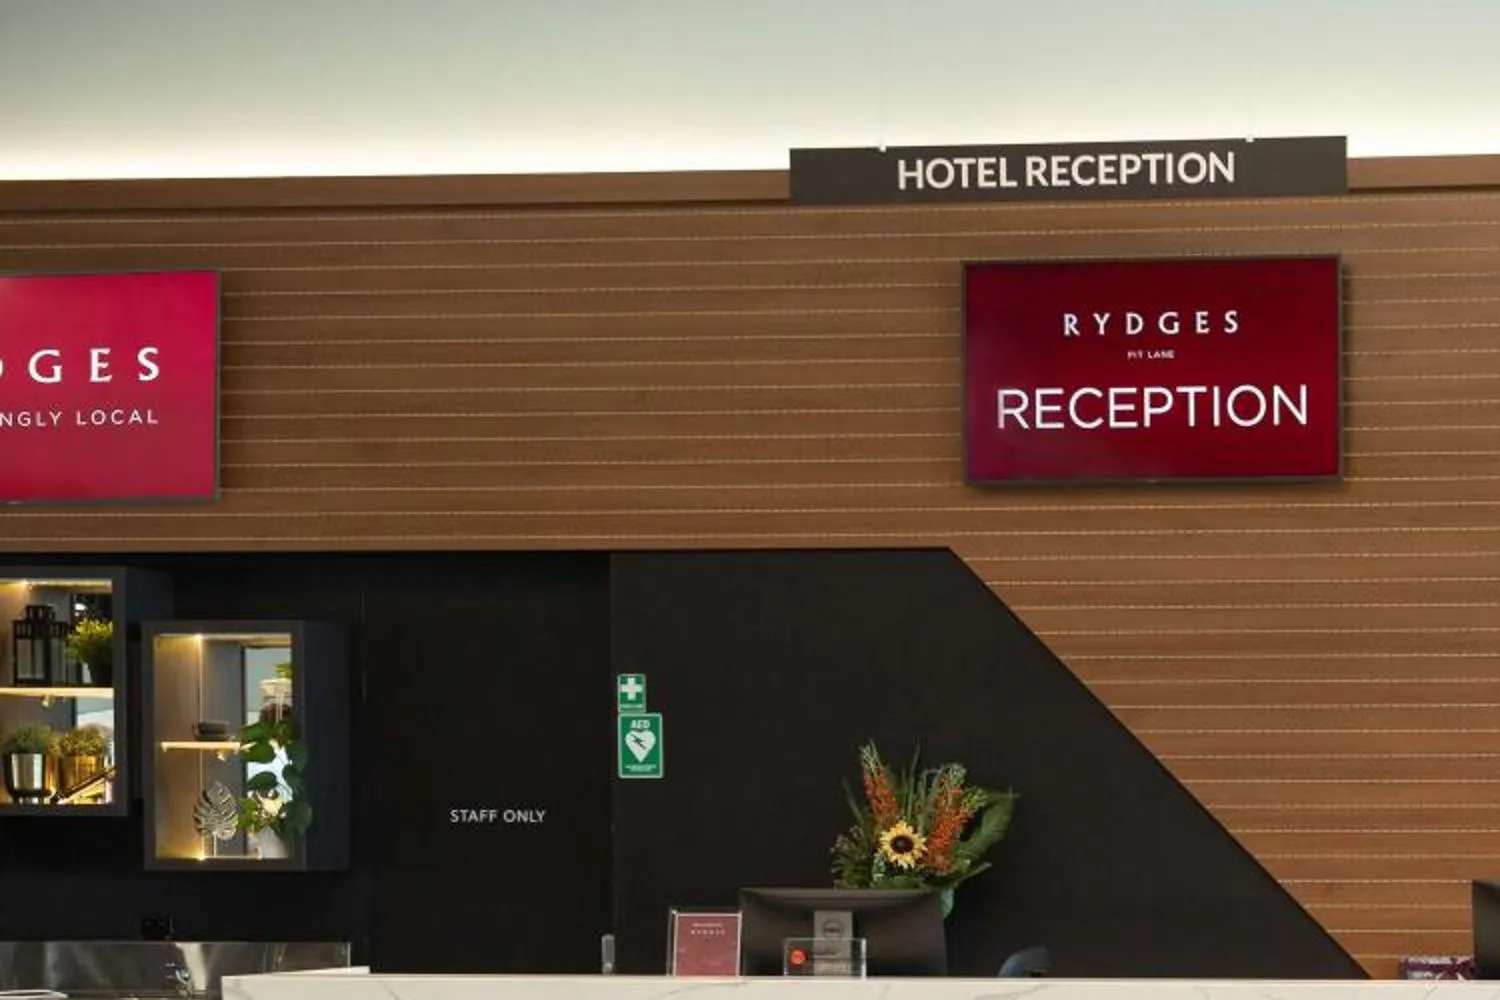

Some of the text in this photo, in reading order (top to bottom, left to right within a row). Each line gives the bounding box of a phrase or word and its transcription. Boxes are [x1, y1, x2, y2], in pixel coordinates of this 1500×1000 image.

[898, 151, 1236, 190] HOTEL RECEPTION
[1063, 310, 1239, 337] RYDGES
[0, 347, 160, 383] GES
[76, 409, 159, 425] LOCAL
[997, 384, 1307, 429] RECEPTION
[449, 809, 546, 823] STAFF ONLY
